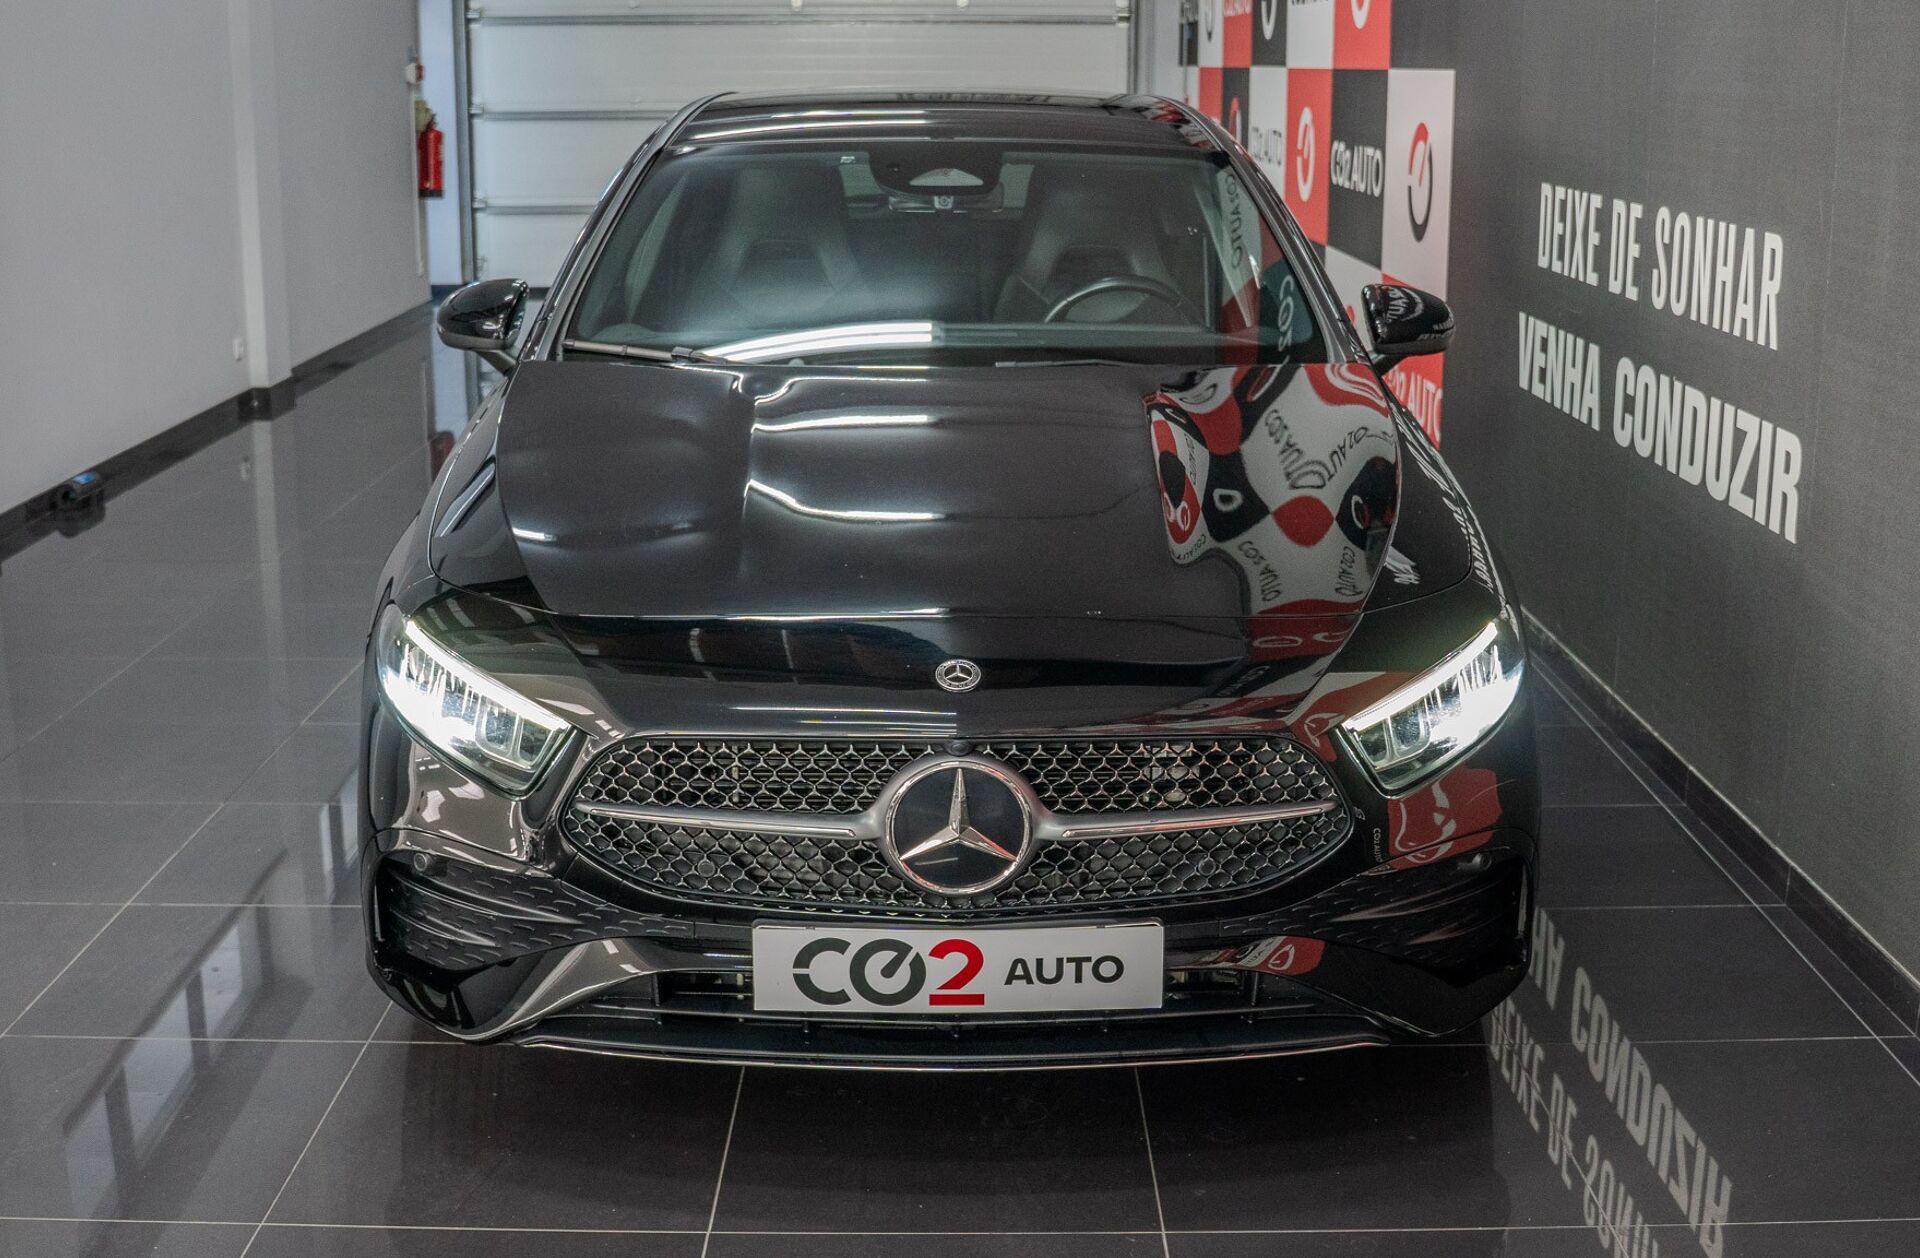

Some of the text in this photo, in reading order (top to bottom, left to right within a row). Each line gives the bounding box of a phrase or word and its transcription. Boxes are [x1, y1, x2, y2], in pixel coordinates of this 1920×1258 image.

[1331, 140, 1384, 198] CO2 AUTO
[1537, 181, 1783, 351] DEIXE DE SONHAR
[1519, 311, 1600, 431] VENHA
[1613, 356, 1802, 544] CONDUZIR
[792, 937, 1125, 1007] CO2 AUTO
